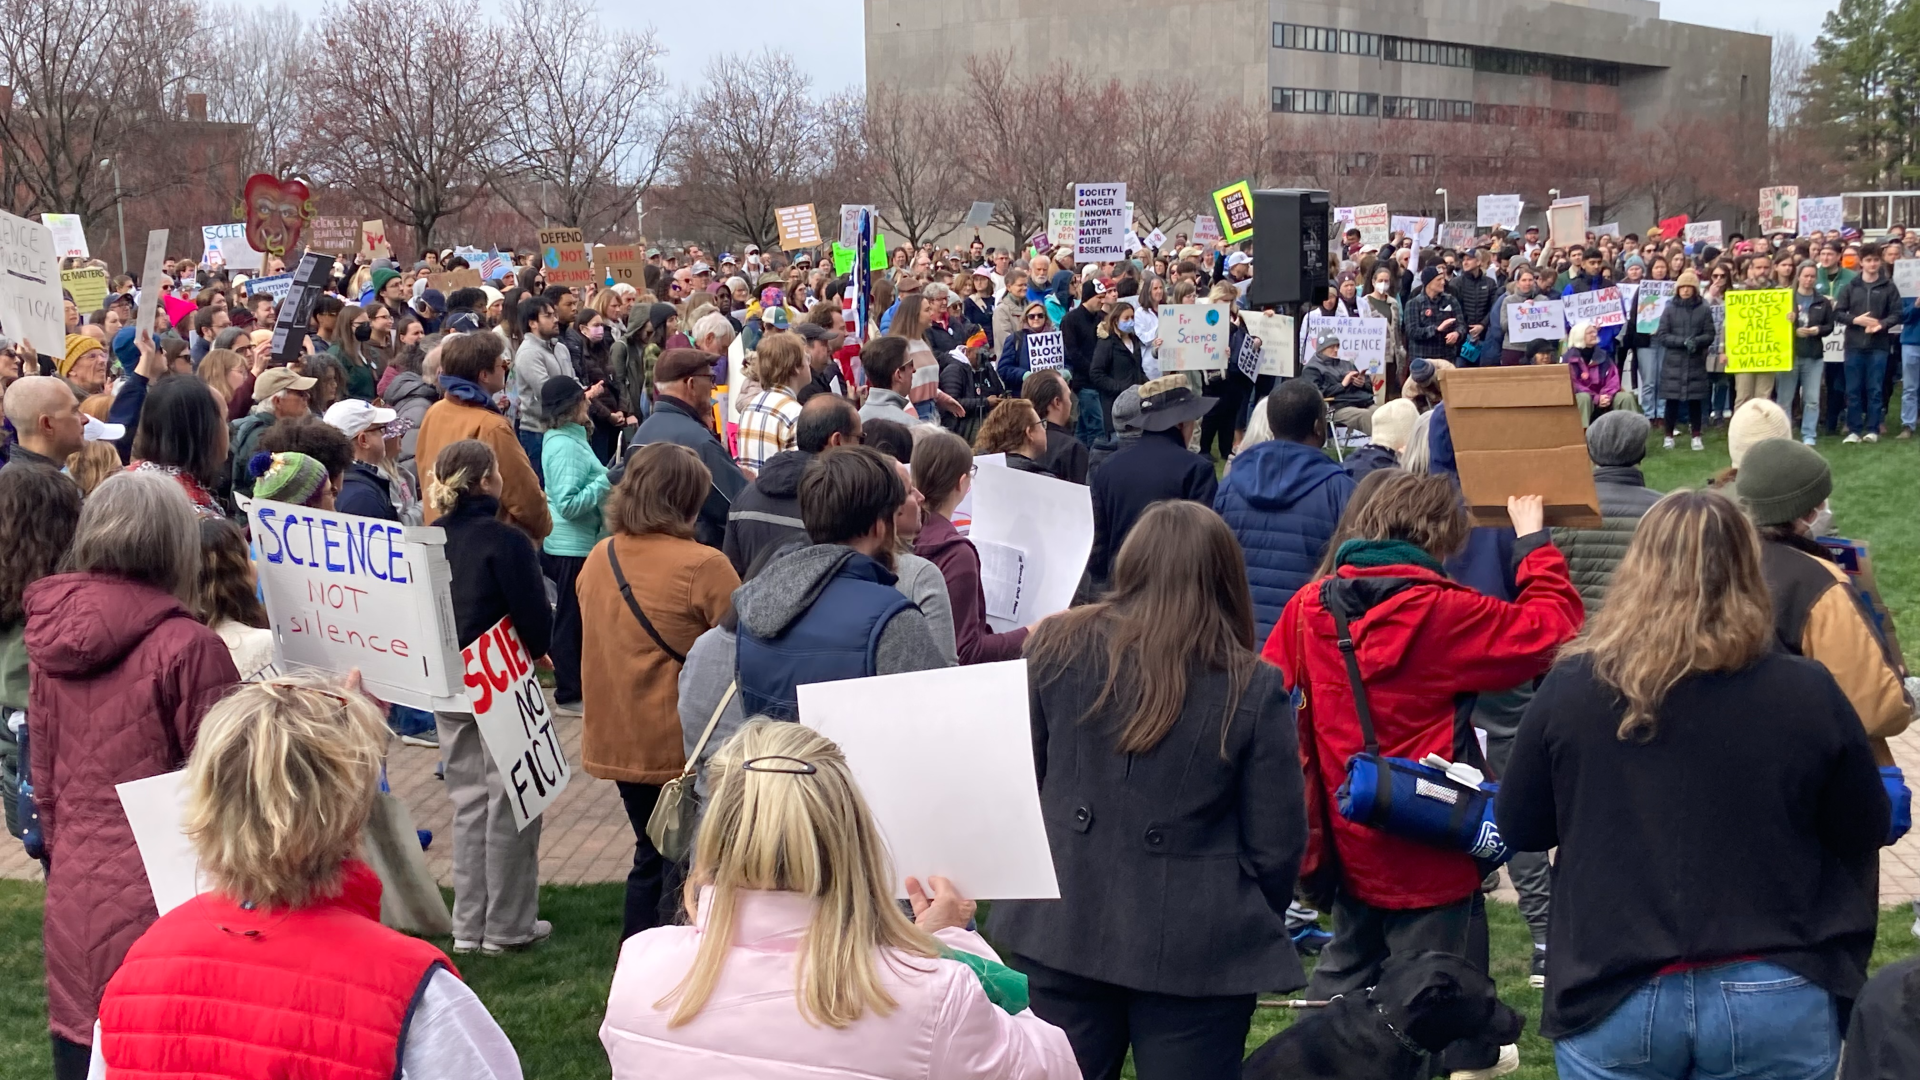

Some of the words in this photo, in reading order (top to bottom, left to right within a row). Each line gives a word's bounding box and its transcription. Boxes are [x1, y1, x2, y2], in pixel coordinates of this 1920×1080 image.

[1079, 188, 1118, 197] SOCIETY
[1079, 198, 1114, 207] CANCER
[1080, 208, 1122, 218] INNOVATE
[1079, 218, 1107, 227] EARTH
[0, 217, 39, 253] ENCE
[1079, 227, 1113, 236] NATURE
[541, 231, 582, 244] DEFEND
[1079, 237, 1101, 245] CURE
[1079, 245, 1123, 254] ESSENTIAL
[561, 251, 583, 262] NOT
[607, 250, 634, 261] TIME
[72, 269, 104, 279] MATTERS
[548, 270, 590, 283] DEFUND
[618, 269, 632, 278] TO
[258, 282, 289, 292] CUTTING
[1728, 292, 1788, 306] INDIRECT
[1519, 306, 1548, 315] SCIENCE
[1739, 304, 1781, 319] COSTS
[1179, 314, 1191, 324] For
[1521, 320, 1549, 329] SILENCE
[1746, 318, 1772, 331] ARE
[1029, 333, 1061, 347] WHY
[1177, 328, 1217, 344] Science
[1738, 330, 1774, 345] BLUE
[1244, 335, 1251, 349] US
[1341, 339, 1381, 350] CIENCE
[1030, 346, 1062, 357] BLOCK
[1731, 342, 1780, 355] COLLAR
[1031, 356, 1063, 366] CANCER
[1739, 355, 1781, 368] WAGES
[258, 508, 407, 584] SCIENCE
[307, 579, 368, 613] NOT
[290, 610, 409, 657] silence
[515, 671, 545, 739] NO
[510, 718, 567, 819] FICT
